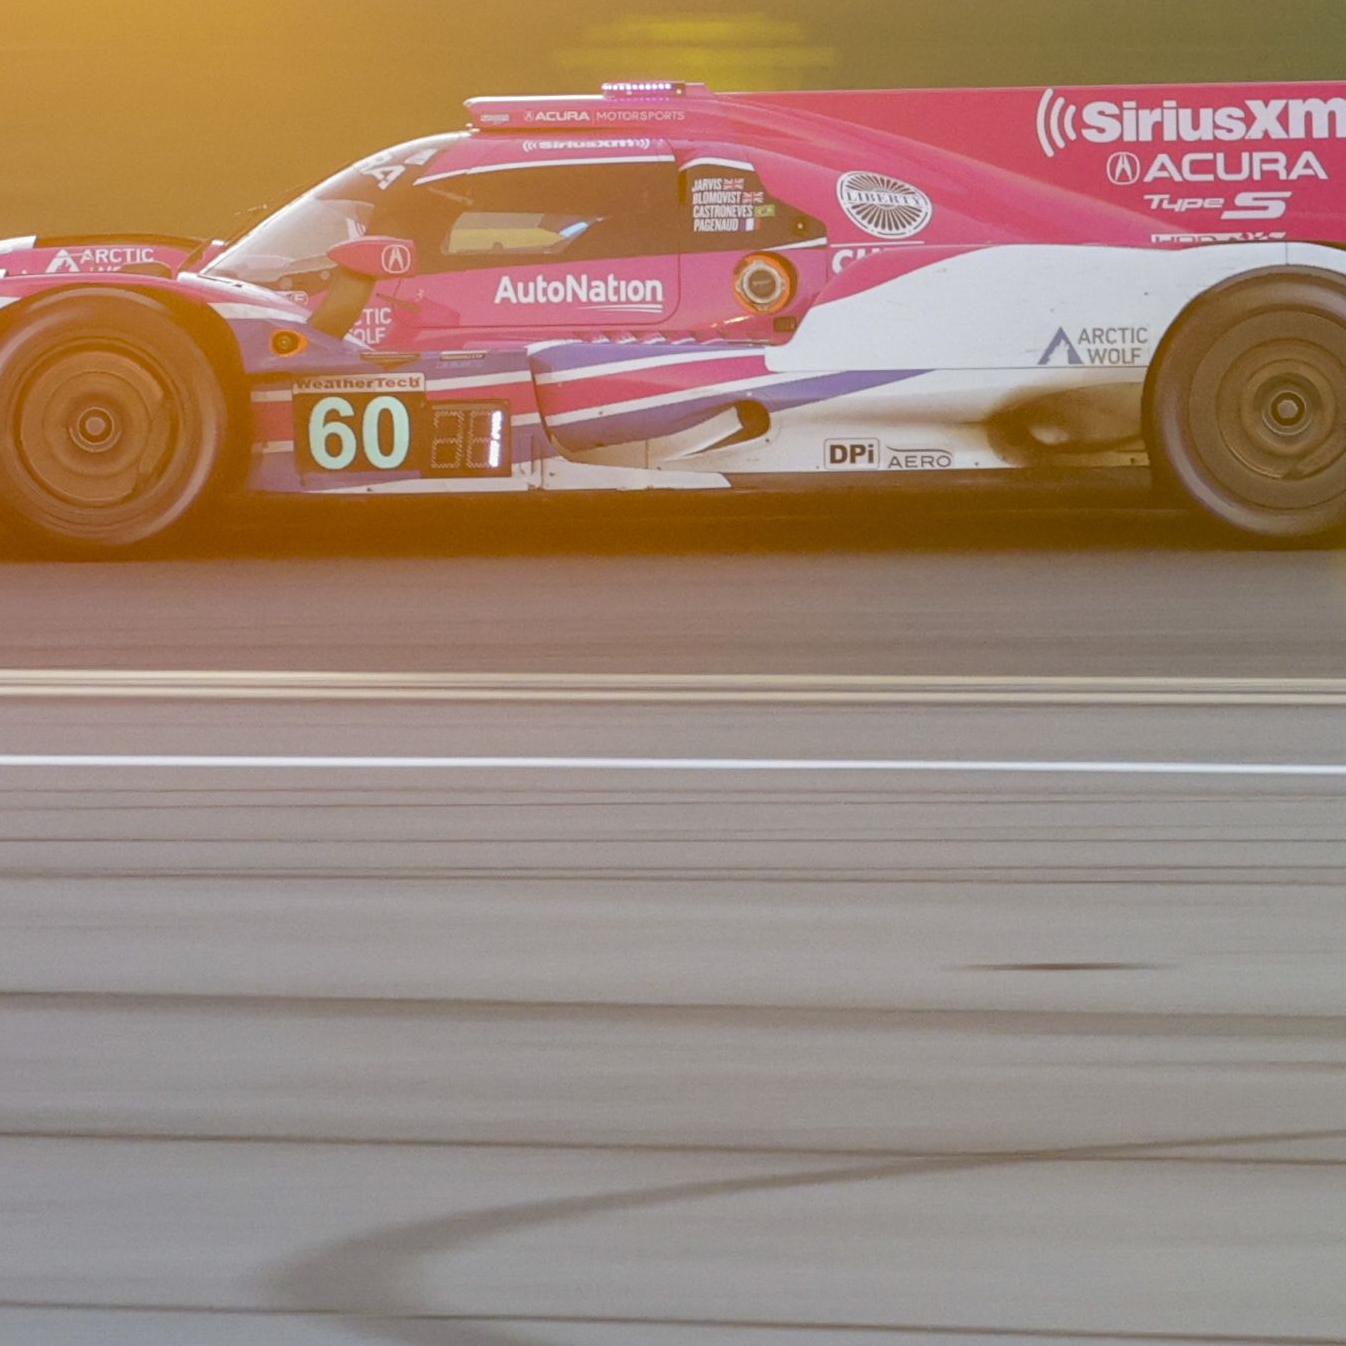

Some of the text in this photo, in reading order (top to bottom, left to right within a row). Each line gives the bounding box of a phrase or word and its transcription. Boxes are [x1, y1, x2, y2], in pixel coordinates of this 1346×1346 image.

[535, 111, 686, 121] ACURA MOTORSPORTS
[1143, 151, 1328, 182] ACURA
[692, 178, 722, 192] JARVIS
[693, 191, 741, 204] BLOMQVIST
[845, 191, 922, 207] LIBERTY
[1220, 191, 1292, 220] S
[693, 204, 753, 218] CASTRONEVES
[694, 218, 738, 232] PAGENAUD
[80, 248, 154, 264] ARCTIC
[493, 273, 663, 304] AutoNation
[1078, 327, 1148, 345] ARCTIC
[1087, 348, 1142, 365] WOLF
[298, 376, 420, 389] WeatherTech
[309, 396, 410, 469] 60
[830, 444, 874, 464] DPi
[887, 455, 951, 469] AERO
